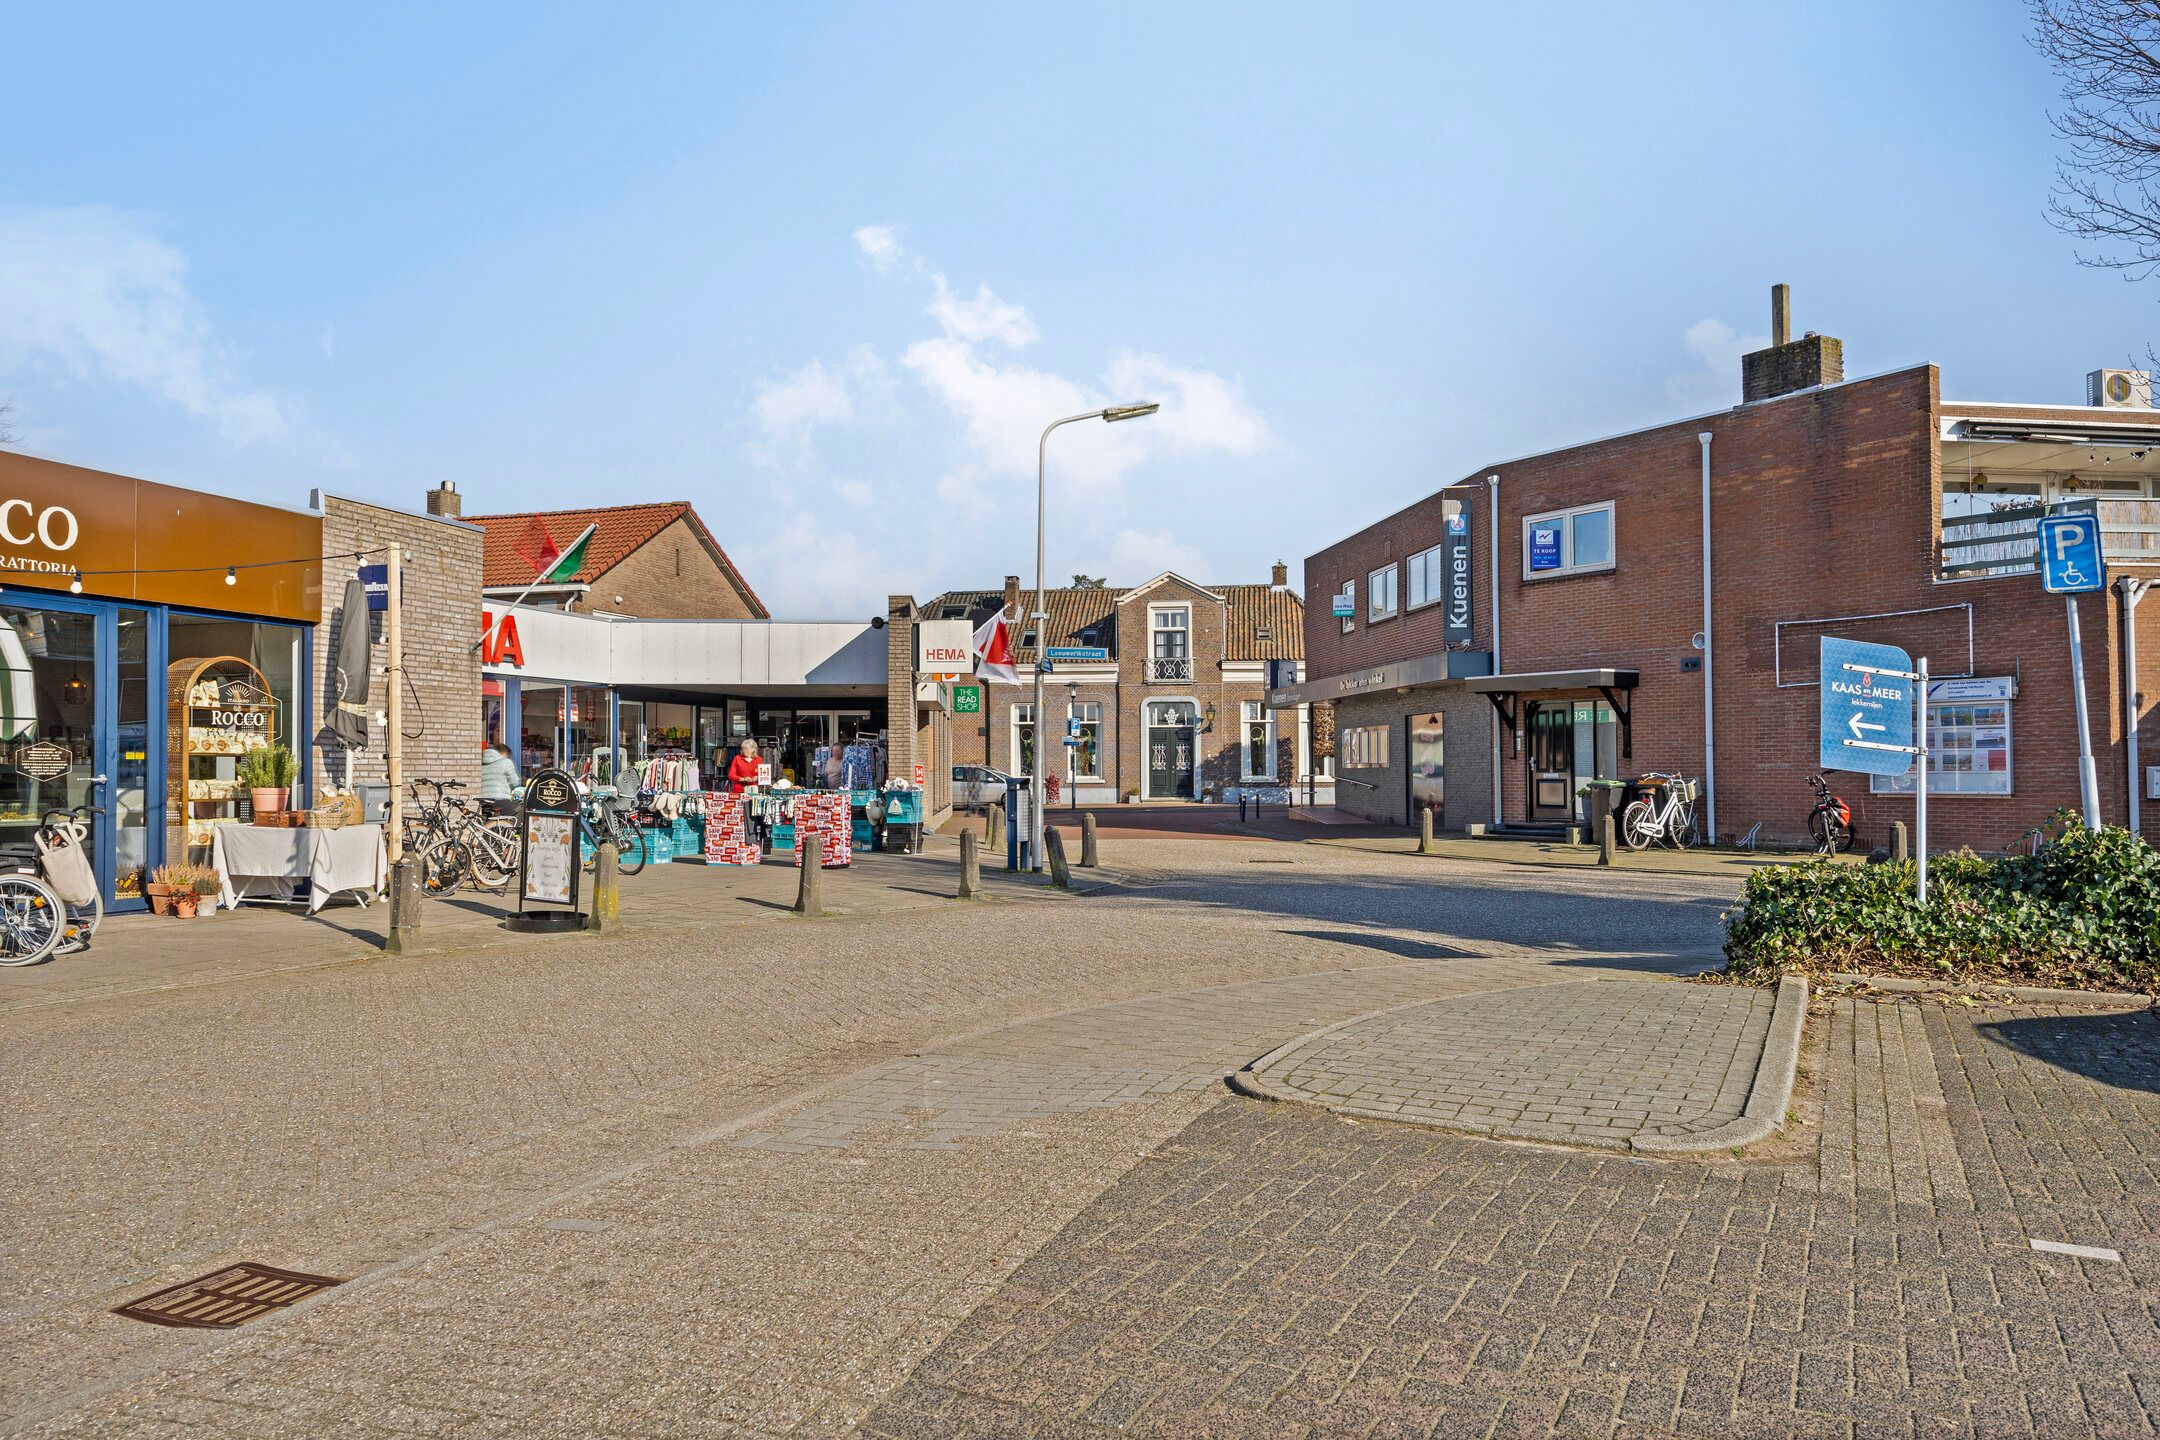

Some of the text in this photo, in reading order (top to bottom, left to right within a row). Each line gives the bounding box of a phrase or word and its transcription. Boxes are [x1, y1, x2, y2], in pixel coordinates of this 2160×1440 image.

[0, 499, 79, 551] CO
[2055, 524, 2085, 560] P
[1450, 545, 1468, 628] Kuenen
[926, 648, 966, 661] HEMA
[960, 688, 973, 696] THE
[1832, 682, 1862, 695] KAAS
[1872, 686, 1902, 700] MEER
[957, 703, 978, 711] SHOP
[1851, 698, 1883, 709] lekkernijen
[212, 710, 264, 726] ROCCO
[1073, 720, 1078, 728] P
[760, 767, 769, 776] 1+1
